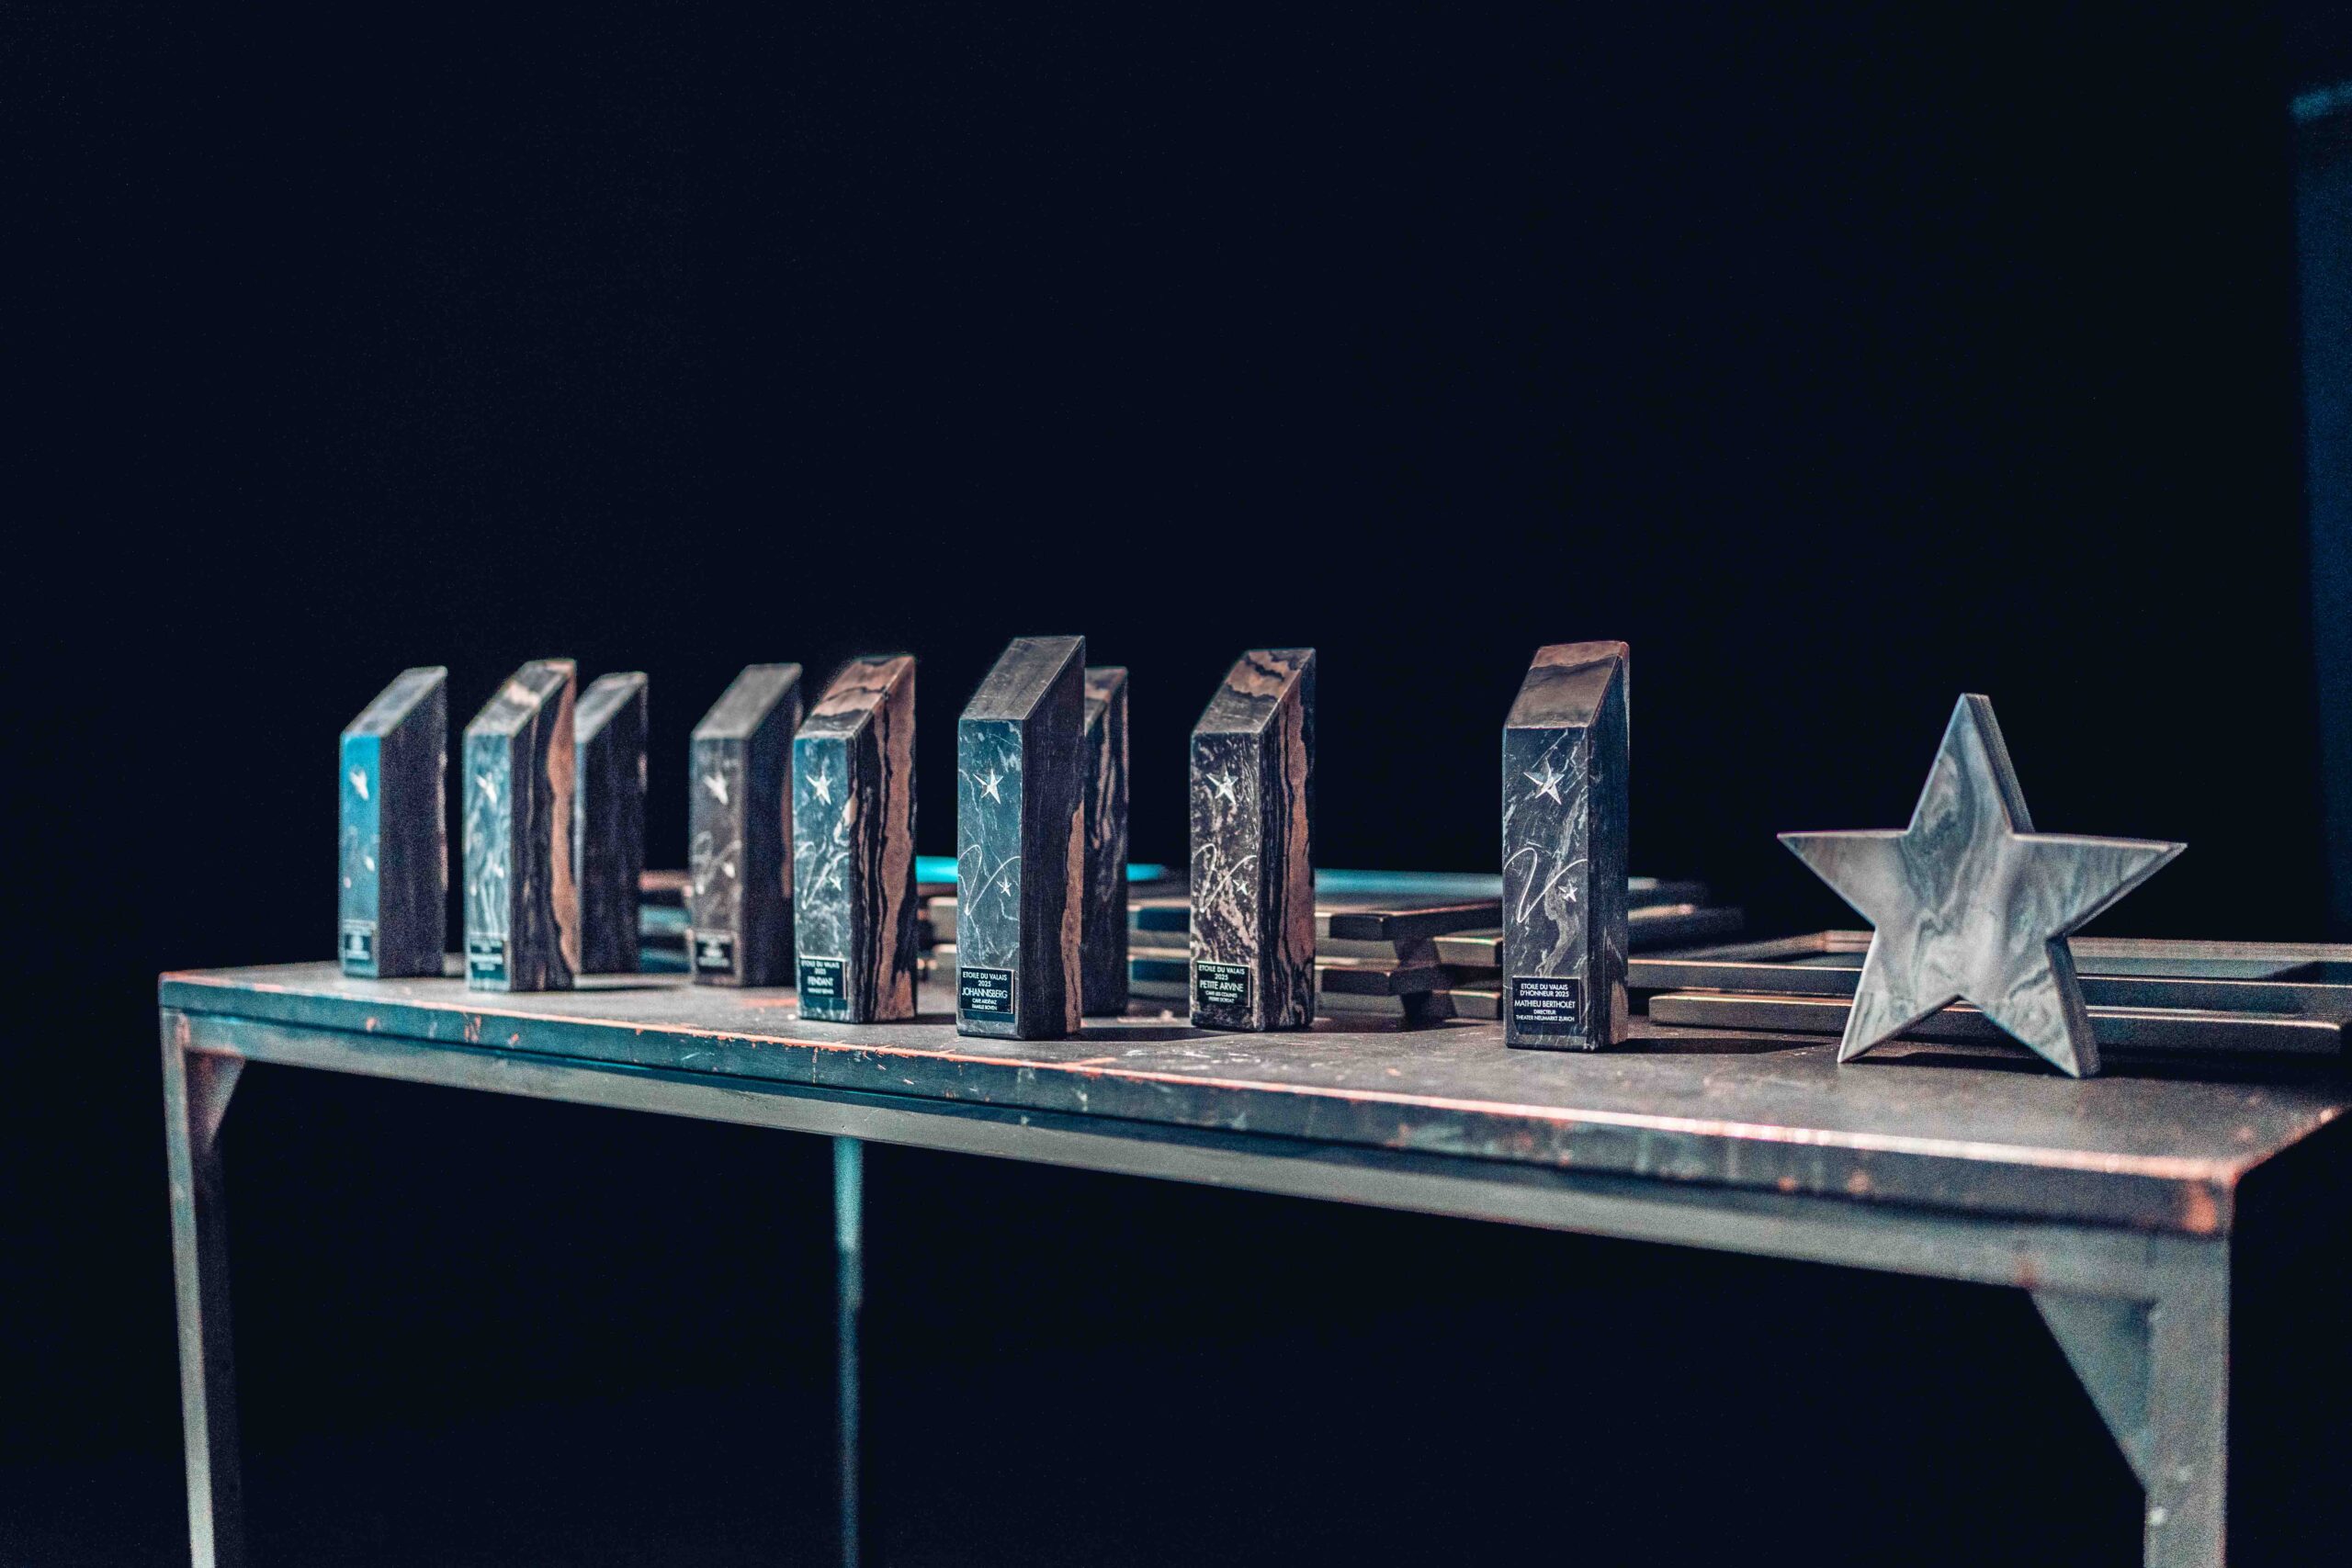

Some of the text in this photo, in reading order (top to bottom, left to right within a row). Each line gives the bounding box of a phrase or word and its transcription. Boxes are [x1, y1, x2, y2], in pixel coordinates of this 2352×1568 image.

[1198, 964, 1216, 973] ETOILE
[1227, 966, 1245, 975] VALAIS
[808, 976, 833, 987] FENDANT
[962, 971, 979, 979] ETOILE
[989, 973, 1008, 981] VALAIS
[978, 979, 991, 987] 2025
[1199, 979, 1244, 992] PETITE ARVINE
[961, 987, 1008, 998] JOHANNISBERG
[1514, 999, 1542, 1008] MATHIEU
